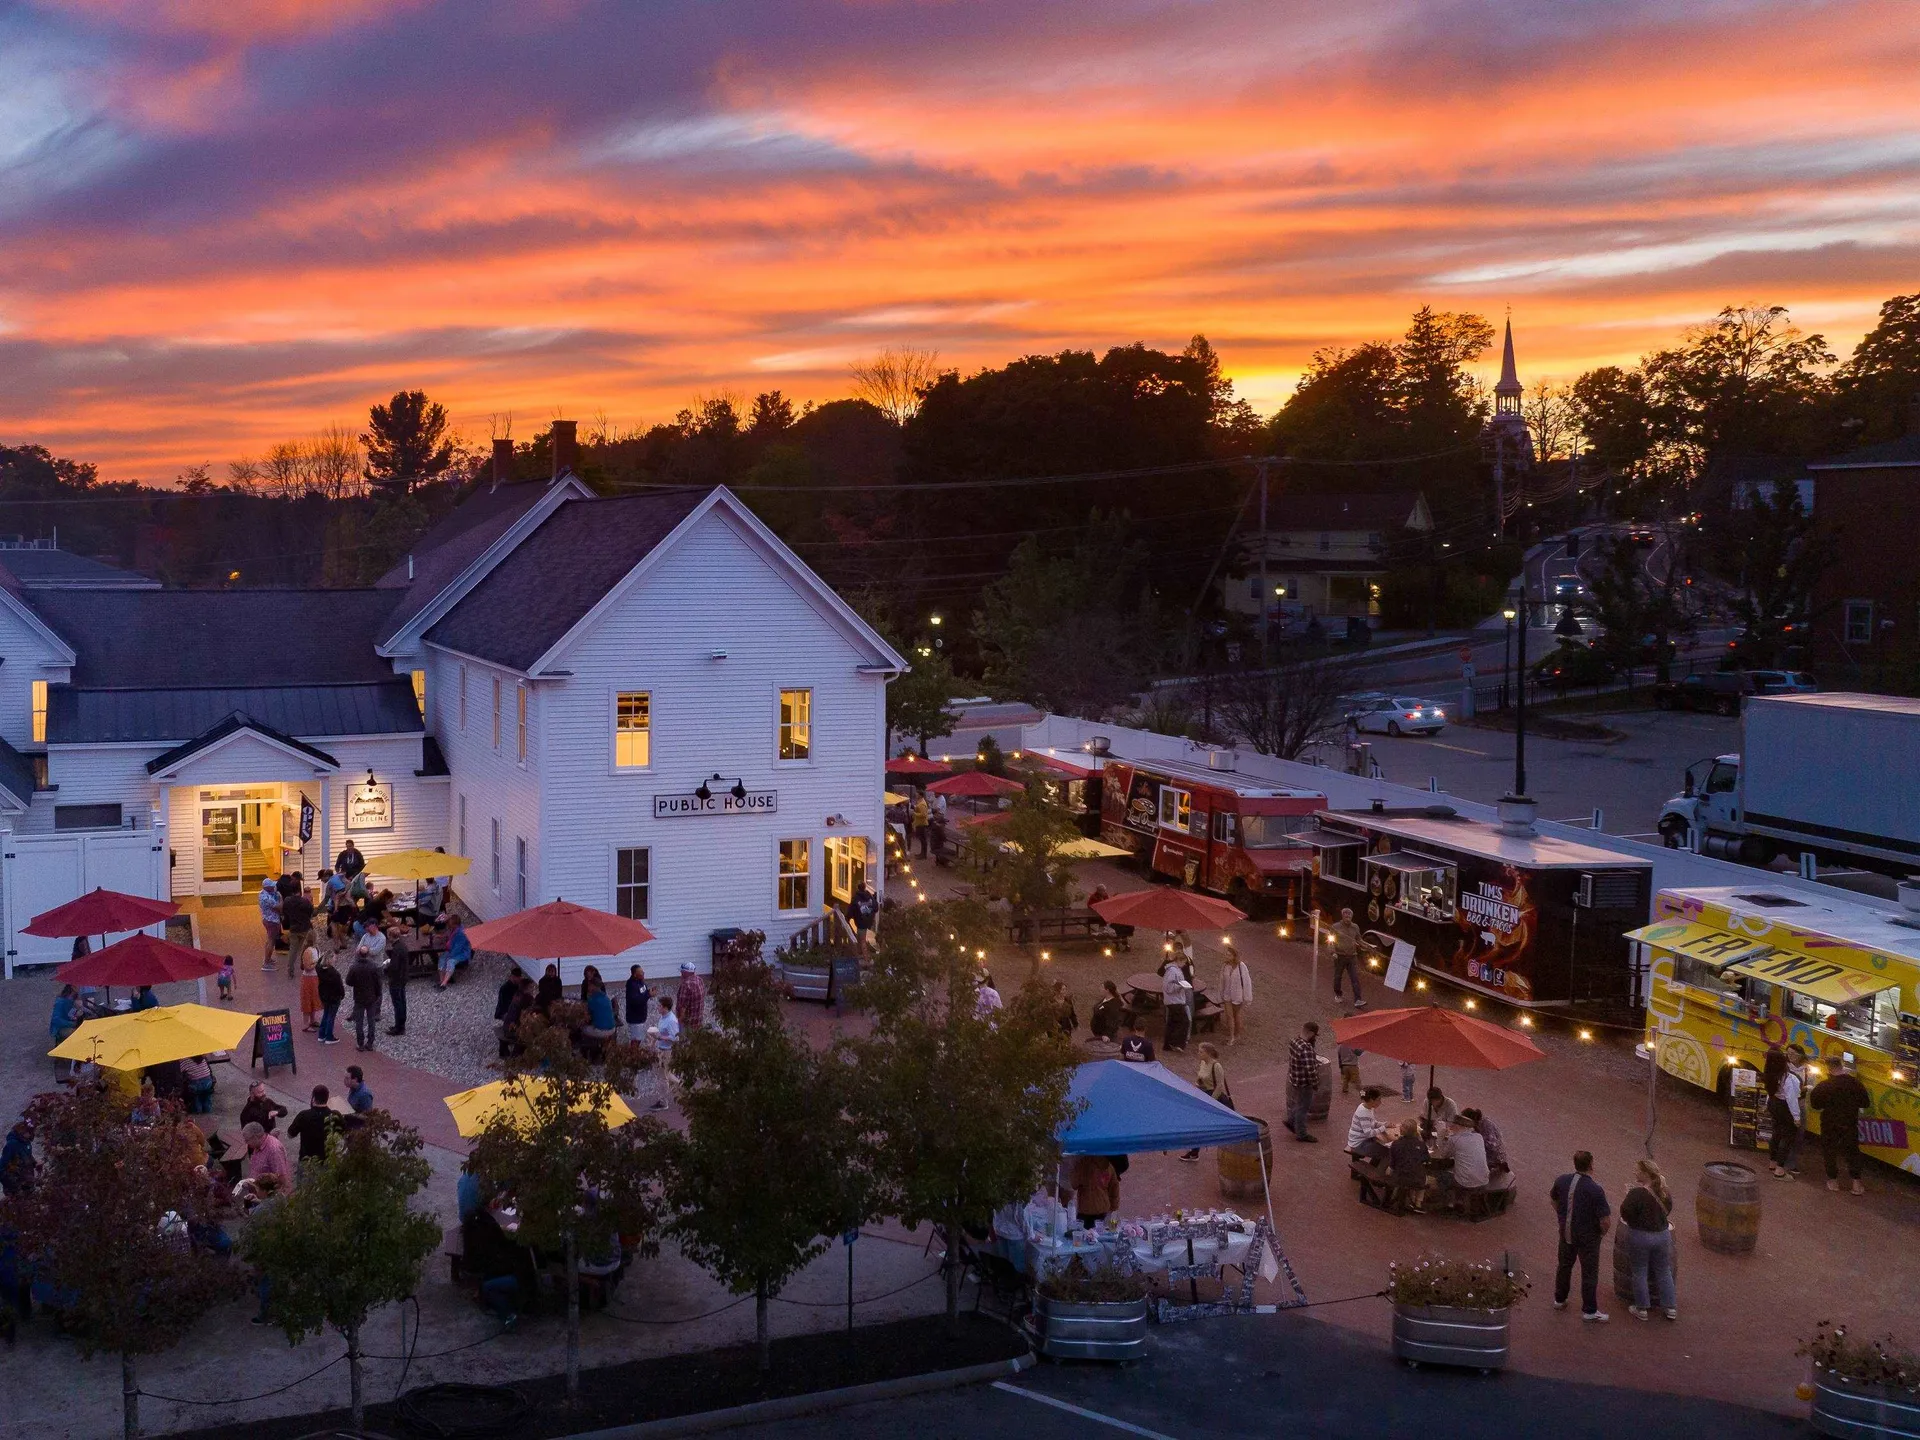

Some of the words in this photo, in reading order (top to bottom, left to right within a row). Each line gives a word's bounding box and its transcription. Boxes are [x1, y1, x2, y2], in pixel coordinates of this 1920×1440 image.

[658, 798, 716, 812] PUBLIC
[724, 795, 774, 809] HOUSE
[1478, 881, 1503, 901] TIM'S
[1461, 893, 1521, 925] DRUNKEN
[1466, 911, 1482, 927] BBQ
[1482, 916, 1491, 927] &
[1490, 918, 1513, 935] TACOS
[1679, 932, 1844, 985] FREND
[262, 1014, 288, 1026] ENTRANCE
[266, 1024, 283, 1032] THIS
[267, 1031, 283, 1042] WAY
